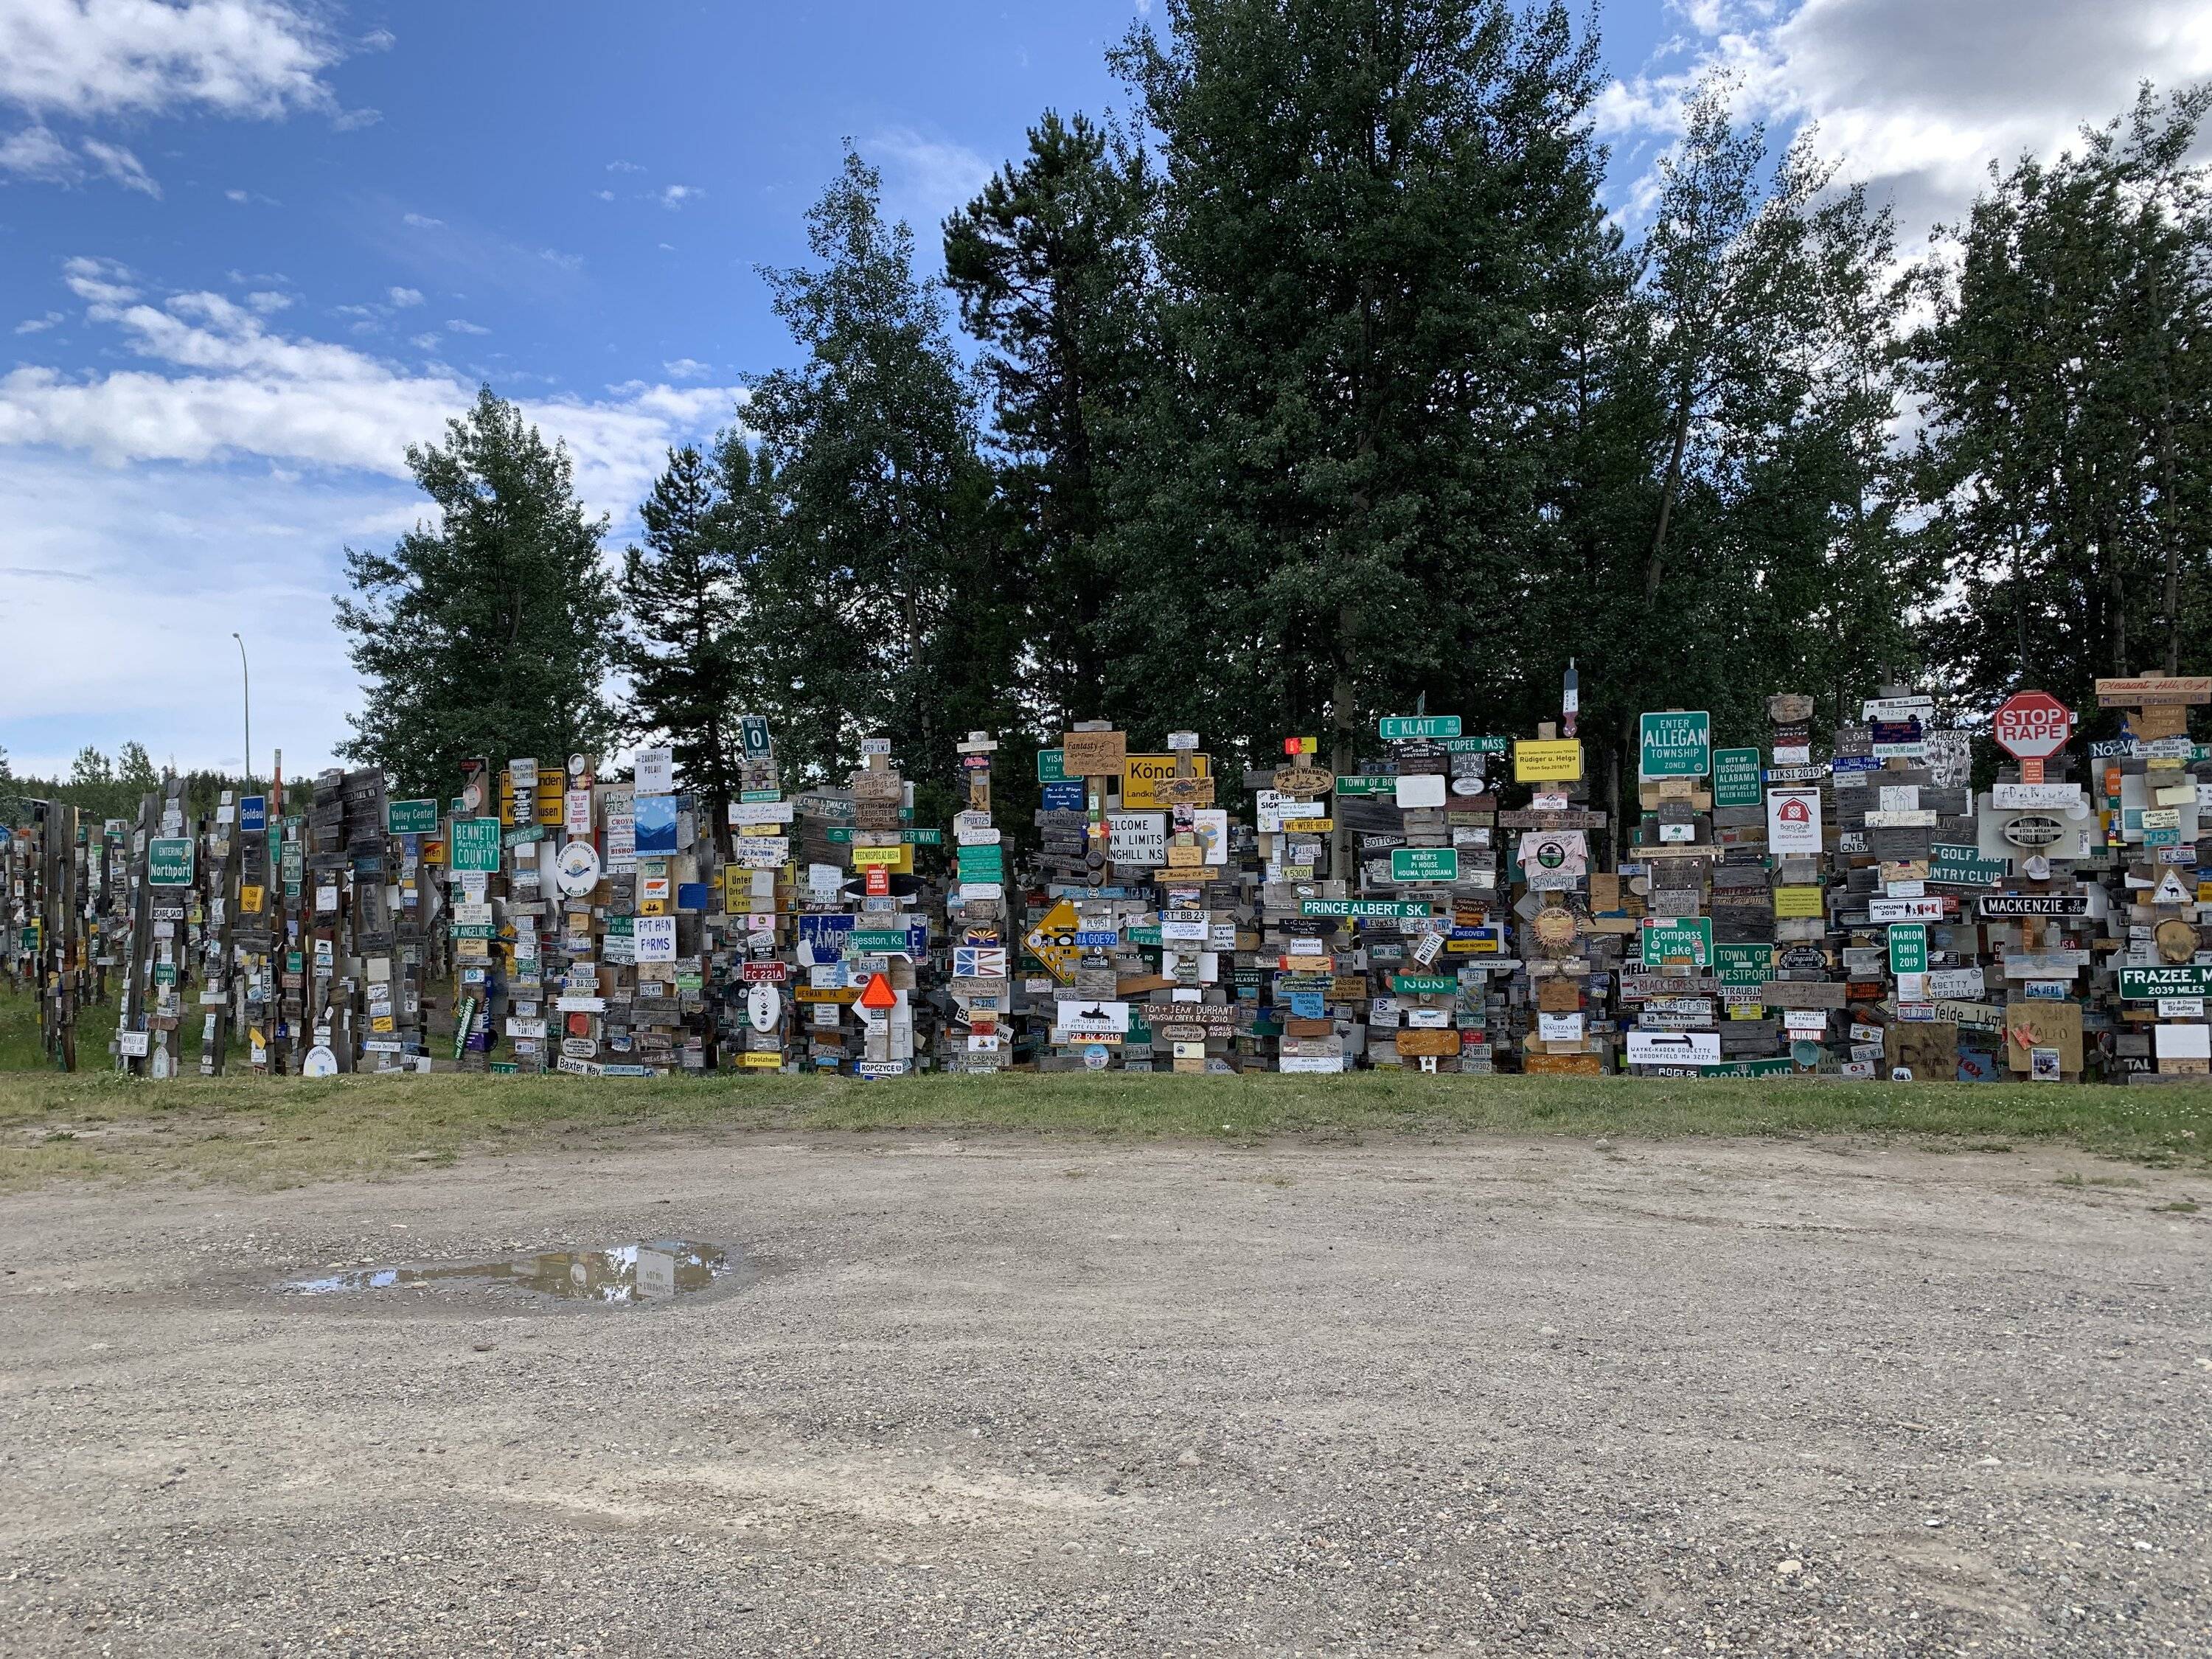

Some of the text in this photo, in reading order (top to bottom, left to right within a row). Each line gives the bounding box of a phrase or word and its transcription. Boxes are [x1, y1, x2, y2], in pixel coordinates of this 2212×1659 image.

[2099, 681, 2149, 692] Pleasant
[2003, 709, 2062, 724] STOP
[747, 720, 762, 728] MILE
[1388, 721, 1395, 734] E.
[1402, 720, 1436, 734] KLATT
[1660, 720, 1688, 728] ENTER
[1644, 728, 1706, 747] ALLEGAN
[2003, 726, 2062, 740] RAPE
[751, 731, 762, 747] 0
[1652, 749, 1699, 758] TOWNSHIP
[1277, 770, 1293, 779] ROBIN
[1301, 768, 1329, 777] WARREN
[1717, 764, 1758, 773] TUSCUMBIA
[1719, 774, 1755, 783] ALABAMA
[1770, 769, 1819, 779] TIKSI 2019
[243, 808, 263, 820] Goldau
[392, 809, 434, 821] Valley Center
[1286, 821, 1330, 830] WE-WERE-HERE
[456, 826, 495, 840] BENNETT
[919, 831, 935, 842] WAY
[506, 832, 530, 846] BRAGG
[1129, 835, 1162, 844] LIMITS
[159, 846, 183, 856] ENTERING
[1857, 843, 1868, 851] 67
[458, 850, 493, 864] COUNTY
[1149, 850, 1164, 860] N.S.
[1941, 849, 1972, 860] GOLF
[150, 864, 190, 877] Northport
[1290, 869, 1311, 877] 53001
[1533, 877, 1574, 886] SAYWARD
[1305, 902, 1426, 916] PRINCE ALBERT SK.
[1989, 900, 2062, 913] MACKENZIE
[1164, 911, 1175, 919] RT
[1180, 911, 1192, 919] BB
[639, 919, 671, 932] FAT HEN
[450, 927, 488, 936] SW ANGELINE
[1653, 930, 1702, 941] Compass
[1892, 931, 1923, 939] MARION
[641, 938, 669, 951] FARMS
[852, 935, 888, 945] Hesston,
[891, 935, 904, 944] Ks.
[1665, 944, 1691, 954] Lake
[1898, 944, 1918, 953] OHIO
[1719, 950, 1767, 961] TOWN OF
[1899, 959, 1919, 967] 2019
[746, 970, 782, 979] FC 221A
[1717, 970, 1771, 980] WESTPORT
[2124, 969, 2197, 984] FRAZEE,
[970, 981, 1004, 989] Wanchuk's
[2178, 986, 2205, 994] MILES
[1169, 1006, 1191, 1015] JEAN
[1196, 1006, 1234, 1015] DURRANT
[1985, 1010, 2001, 1026] km
[518, 1027, 535, 1035] FAMILY
[1790, 1030, 1820, 1040] KUKUM
[1071, 1032, 1082, 1041] ZR
[1085, 1033, 1096, 1041] RK
[747, 1056, 780, 1064] Erpolzheim
[560, 1058, 600, 1076] Baxter Way
[1659, 1068, 1697, 1077] ROGERS
